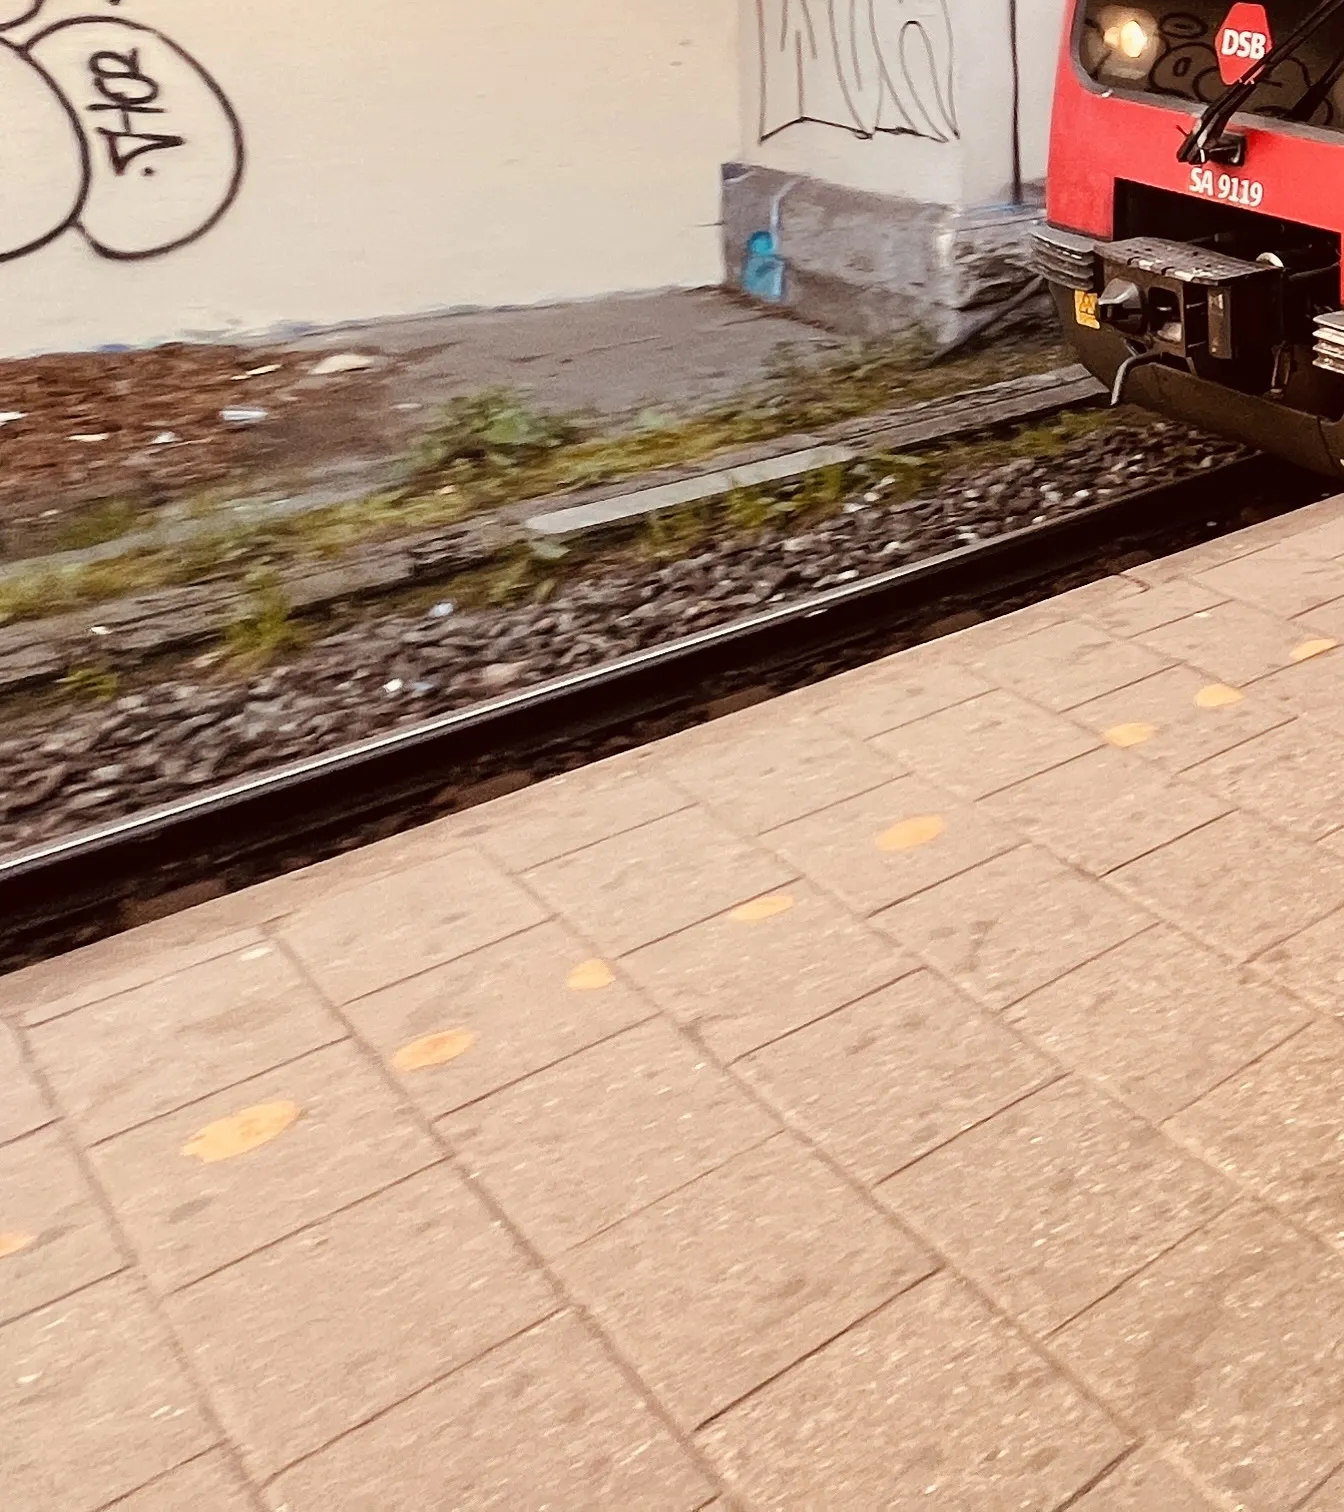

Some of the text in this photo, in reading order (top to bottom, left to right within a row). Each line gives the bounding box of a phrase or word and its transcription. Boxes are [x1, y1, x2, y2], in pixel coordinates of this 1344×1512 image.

[1221, 28, 1266, 60] DSB
[1189, 167, 1264, 207] SA 9119
